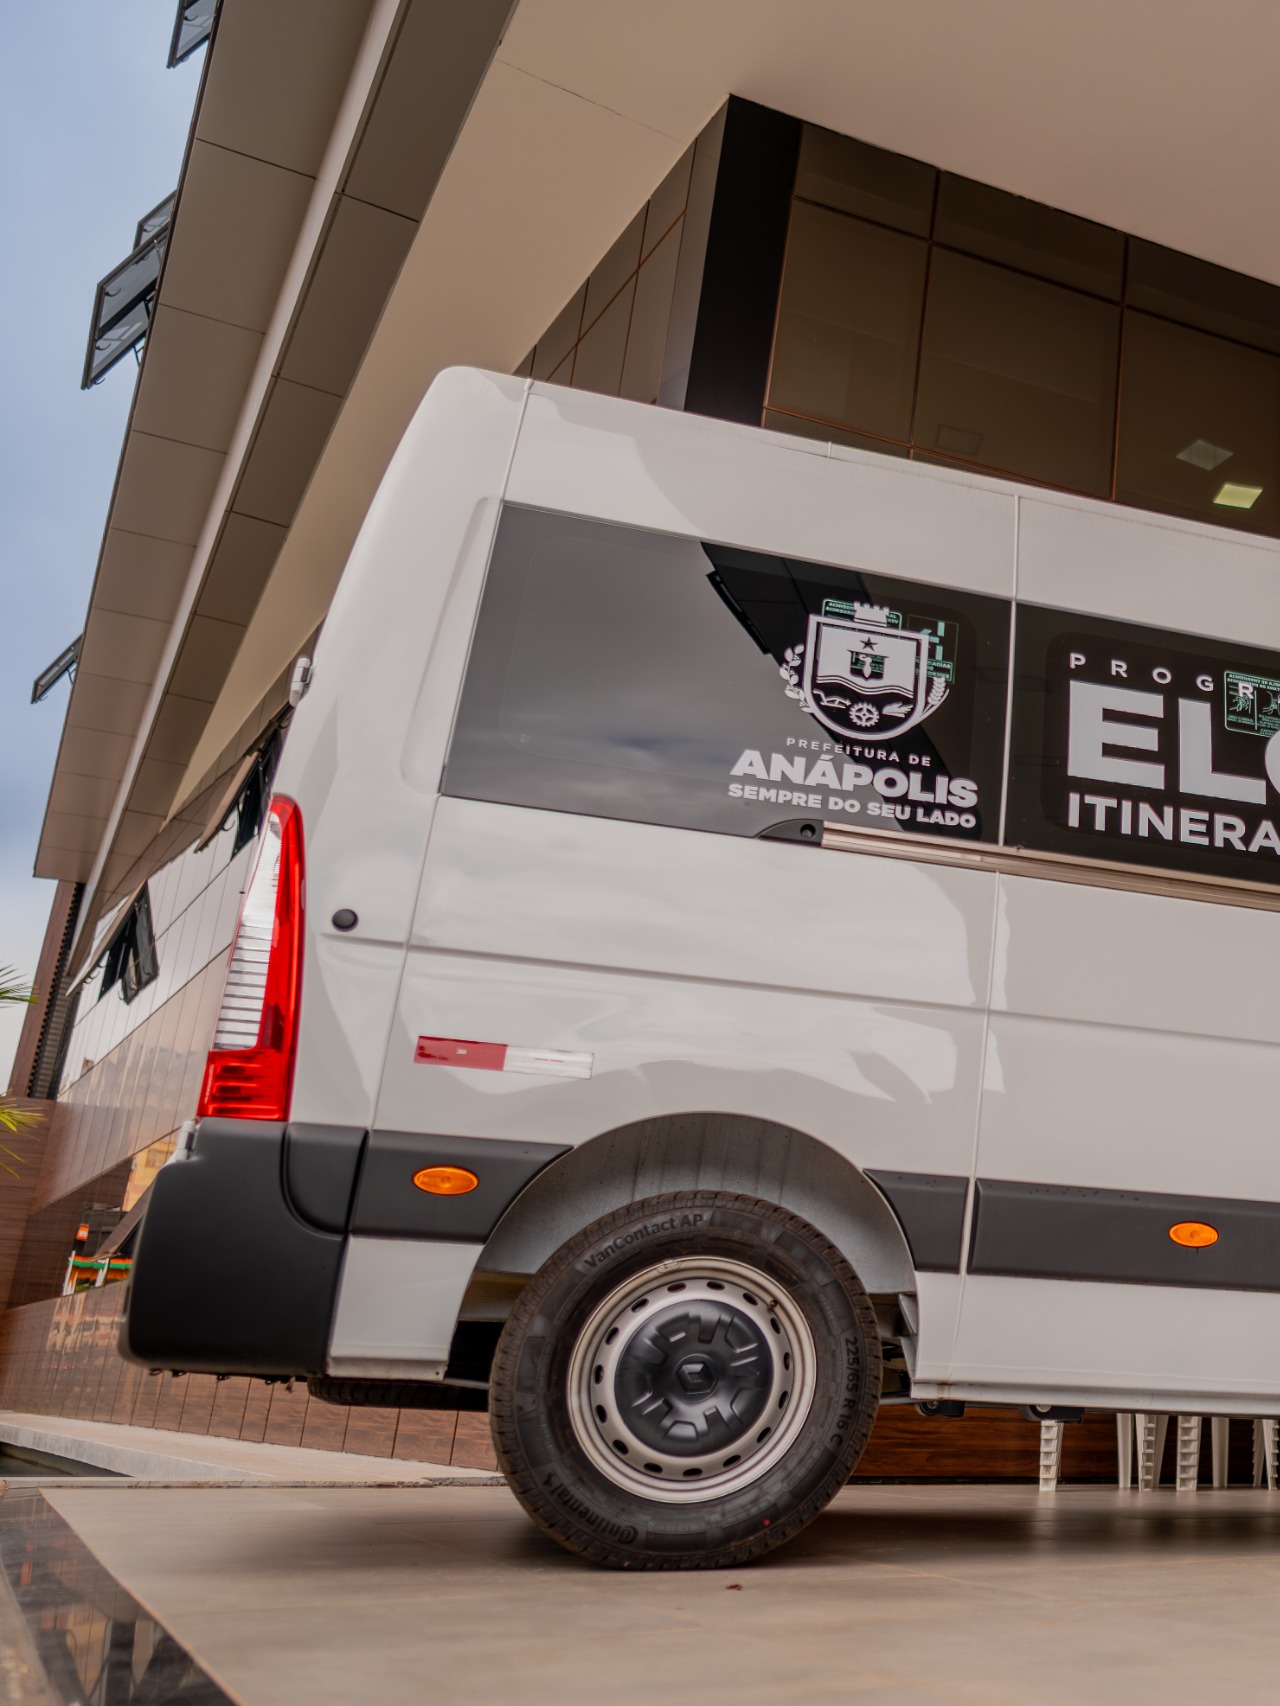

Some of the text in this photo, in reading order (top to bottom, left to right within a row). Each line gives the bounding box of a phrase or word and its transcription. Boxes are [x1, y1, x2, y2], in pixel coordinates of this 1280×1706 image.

[786, 737, 931, 767] PREFEITURA DE
[729, 749, 979, 808] ANÁPOLIS
[727, 783, 977, 829] SEMPRE DO SEU LADO
[583, 1213, 704, 1269] VanContact AP
[845, 1337, 860, 1393] 225/65
[837, 1413, 850, 1431] 16
[842, 1398, 857, 1409] R
